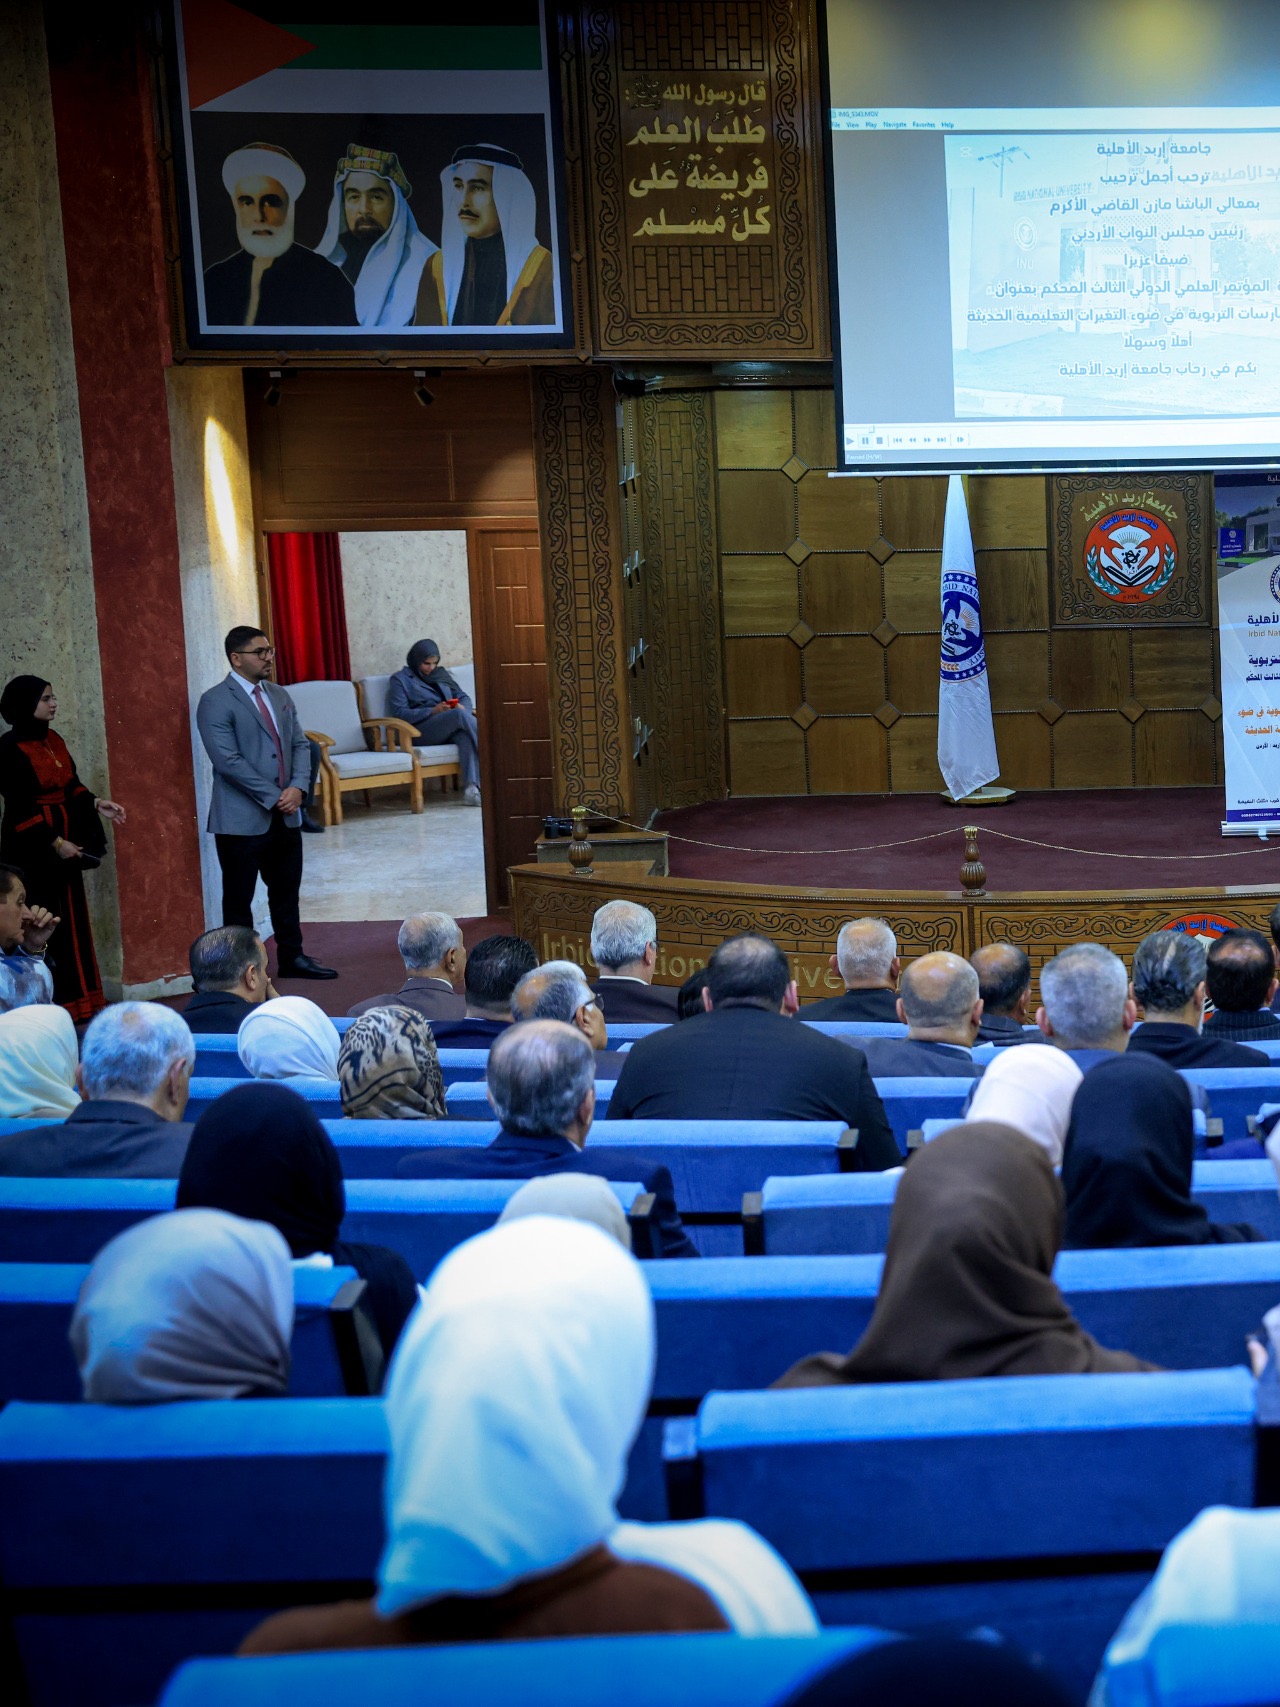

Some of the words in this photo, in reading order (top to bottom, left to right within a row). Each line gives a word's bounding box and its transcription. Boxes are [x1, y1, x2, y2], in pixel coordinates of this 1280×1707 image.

[662, 83, 691, 101] الله
[694, 83, 735, 106] رسول
[738, 80, 767, 106] قال
[1096, 139, 1140, 158] الأهلية
[1143, 141, 1167, 158] إربد
[1169, 141, 1211, 155] جامعة
[1099, 172, 1139, 186] ترحيب
[1140, 165, 1174, 186] أجمل
[1177, 171, 1209, 186] ترحب
[1050, 196, 1087, 216] الأكرم
[1090, 198, 1139, 217] القاضي
[1143, 198, 1172, 214] مازن
[1175, 197, 1212, 211] الباشا
[1216, 197, 1260, 215] بمعالي
[1071, 224, 1115, 245] الأردني
[1118, 226, 1157, 243] النواب
[1160, 225, 1205, 241] مجلس
[1208, 225, 1244, 240] رئيس
[995, 281, 1037, 297] بعنوان
[1040, 281, 1087, 299] المحكم
[1090, 281, 1126, 294] الثالث
[1130, 280, 1171, 299] الدولي
[1175, 280, 1218, 298] العلمي
[1223, 279, 1270, 295] المؤتمر
[967, 309, 1012, 323] الحديثة
[1016, 308, 1073, 324] التعليمية
[1077, 308, 1127, 324] التغيرات
[1131, 308, 1160, 323] ضوء
[1164, 308, 1185, 325] في
[1188, 307, 1234, 323] التربوية
[1059, 360, 1102, 378] الأهلية
[1105, 362, 1127, 378] إربد
[1131, 362, 1172, 376] جامعة
[1175, 362, 1206, 377] رحاب
[1210, 362, 1230, 379] في
[1234, 362, 1257, 378] بكم
[1248, 630, 1266, 638] Irbid
[1245, 725, 1273, 736] الحديثة
